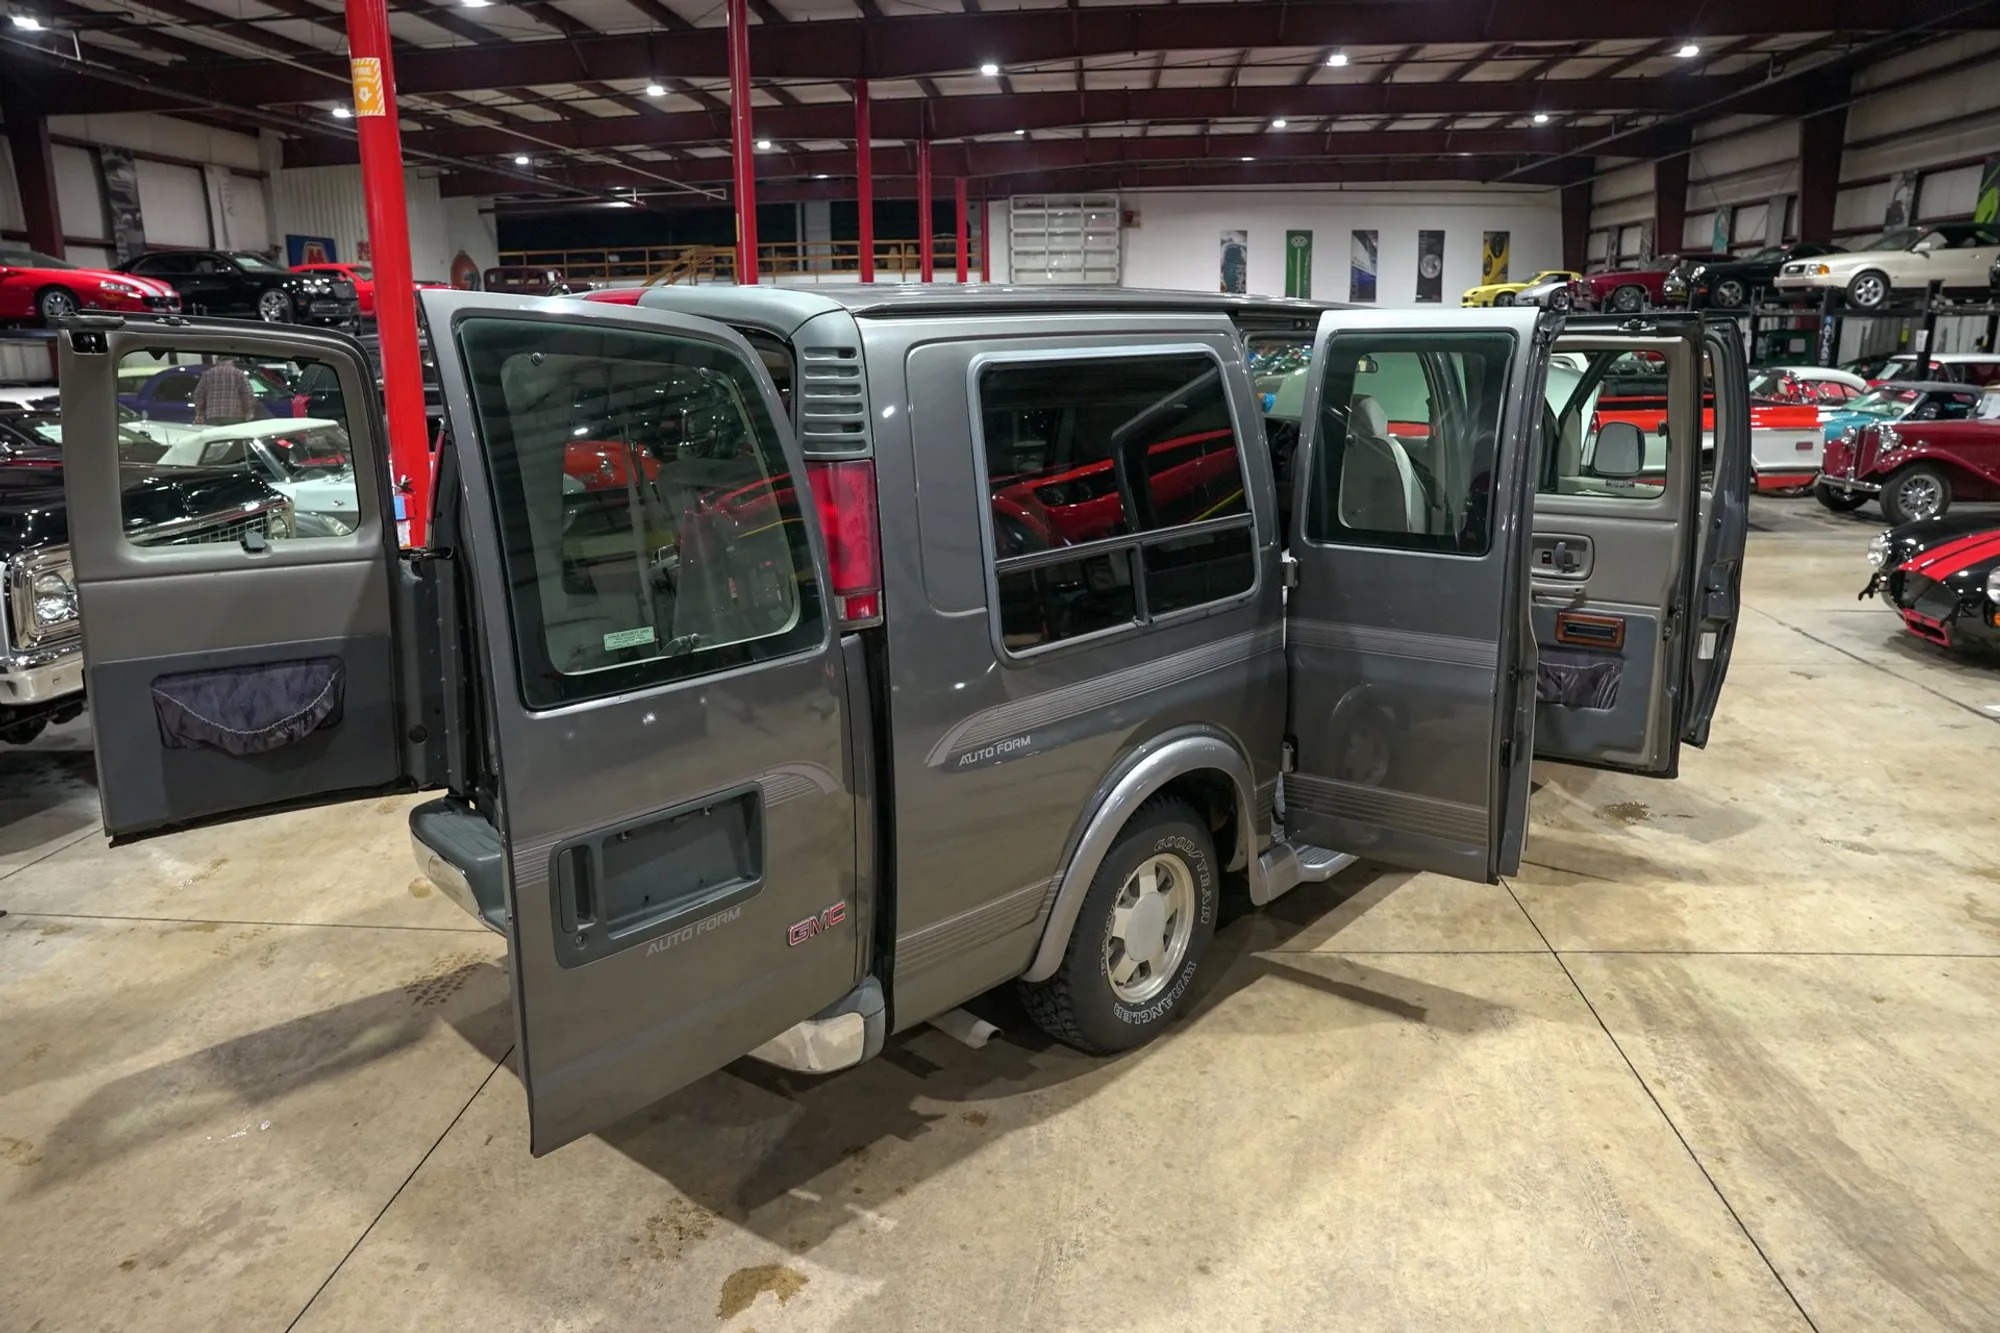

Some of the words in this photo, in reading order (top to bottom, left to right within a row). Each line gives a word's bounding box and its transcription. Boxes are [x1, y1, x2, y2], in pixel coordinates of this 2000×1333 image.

[1820, 324, 1832, 360] ATLAS
[958, 746, 994, 767] AUTO
[996, 735, 1032, 755] FORM
[1154, 836, 1212, 924] GOODYEAR
[646, 927, 693, 957] AUTO
[696, 907, 742, 936] FORM
[786, 899, 846, 947] GMC
[1113, 961, 1197, 1025] WRANGLER
